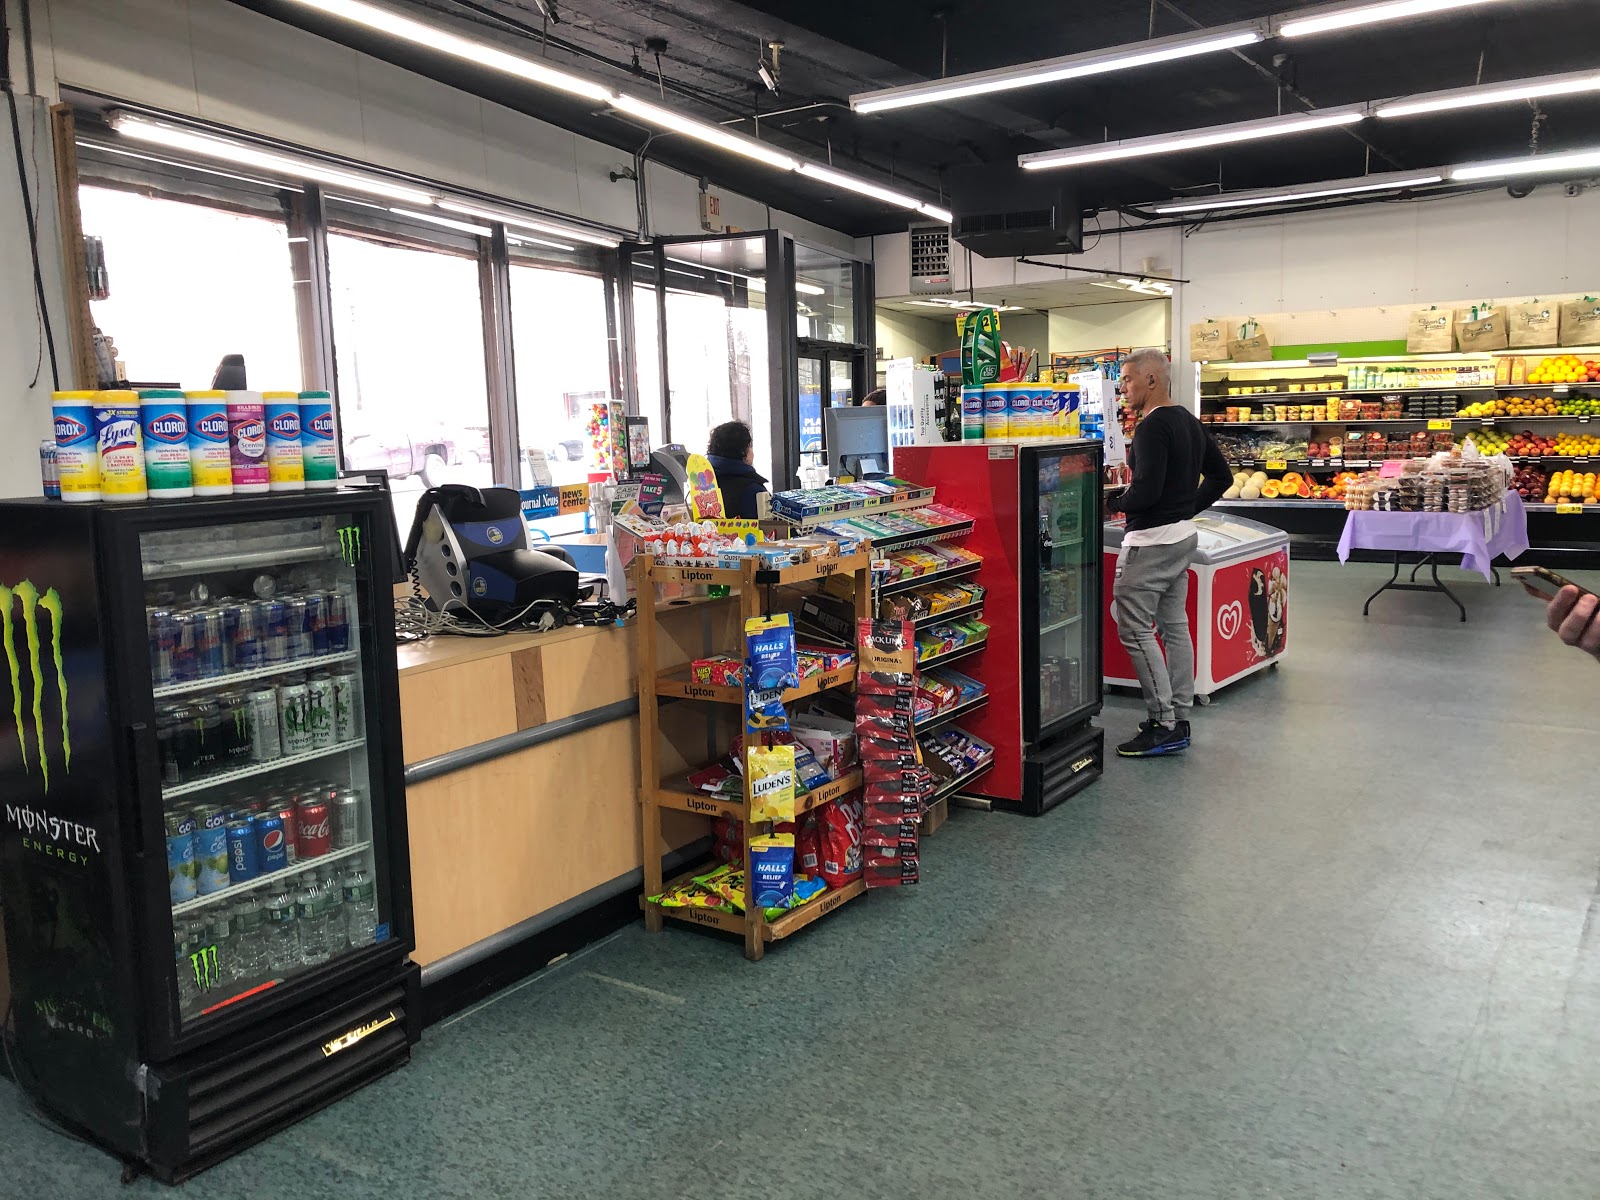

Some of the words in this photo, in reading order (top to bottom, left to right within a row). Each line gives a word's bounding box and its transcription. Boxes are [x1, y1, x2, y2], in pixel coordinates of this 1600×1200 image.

[710, 196, 720, 216] EXIT
[101, 421, 136, 446] Lysol
[153, 422, 187, 433] CLOROX
[562, 490, 582, 499] news
[657, 486, 663, 496] 5
[521, 495, 540, 510] ournal
[543, 494, 558, 507] News
[563, 497, 587, 508] center
[682, 570, 712, 582] Lipton
[755, 643, 784, 652] HALLS
[684, 685, 715, 698] Lipton
[753, 775, 791, 795] LUDEN'S
[819, 786, 840, 800] Lipton
[687, 798, 717, 811] Lipton
[6, 804, 100, 853] MONSTER
[23, 837, 88, 866] ENERGY
[232, 840, 247, 871] pepsi
[758, 864, 786, 872] HALLS
[820, 894, 841, 913] Lipton
[690, 910, 719, 924] Lipton
